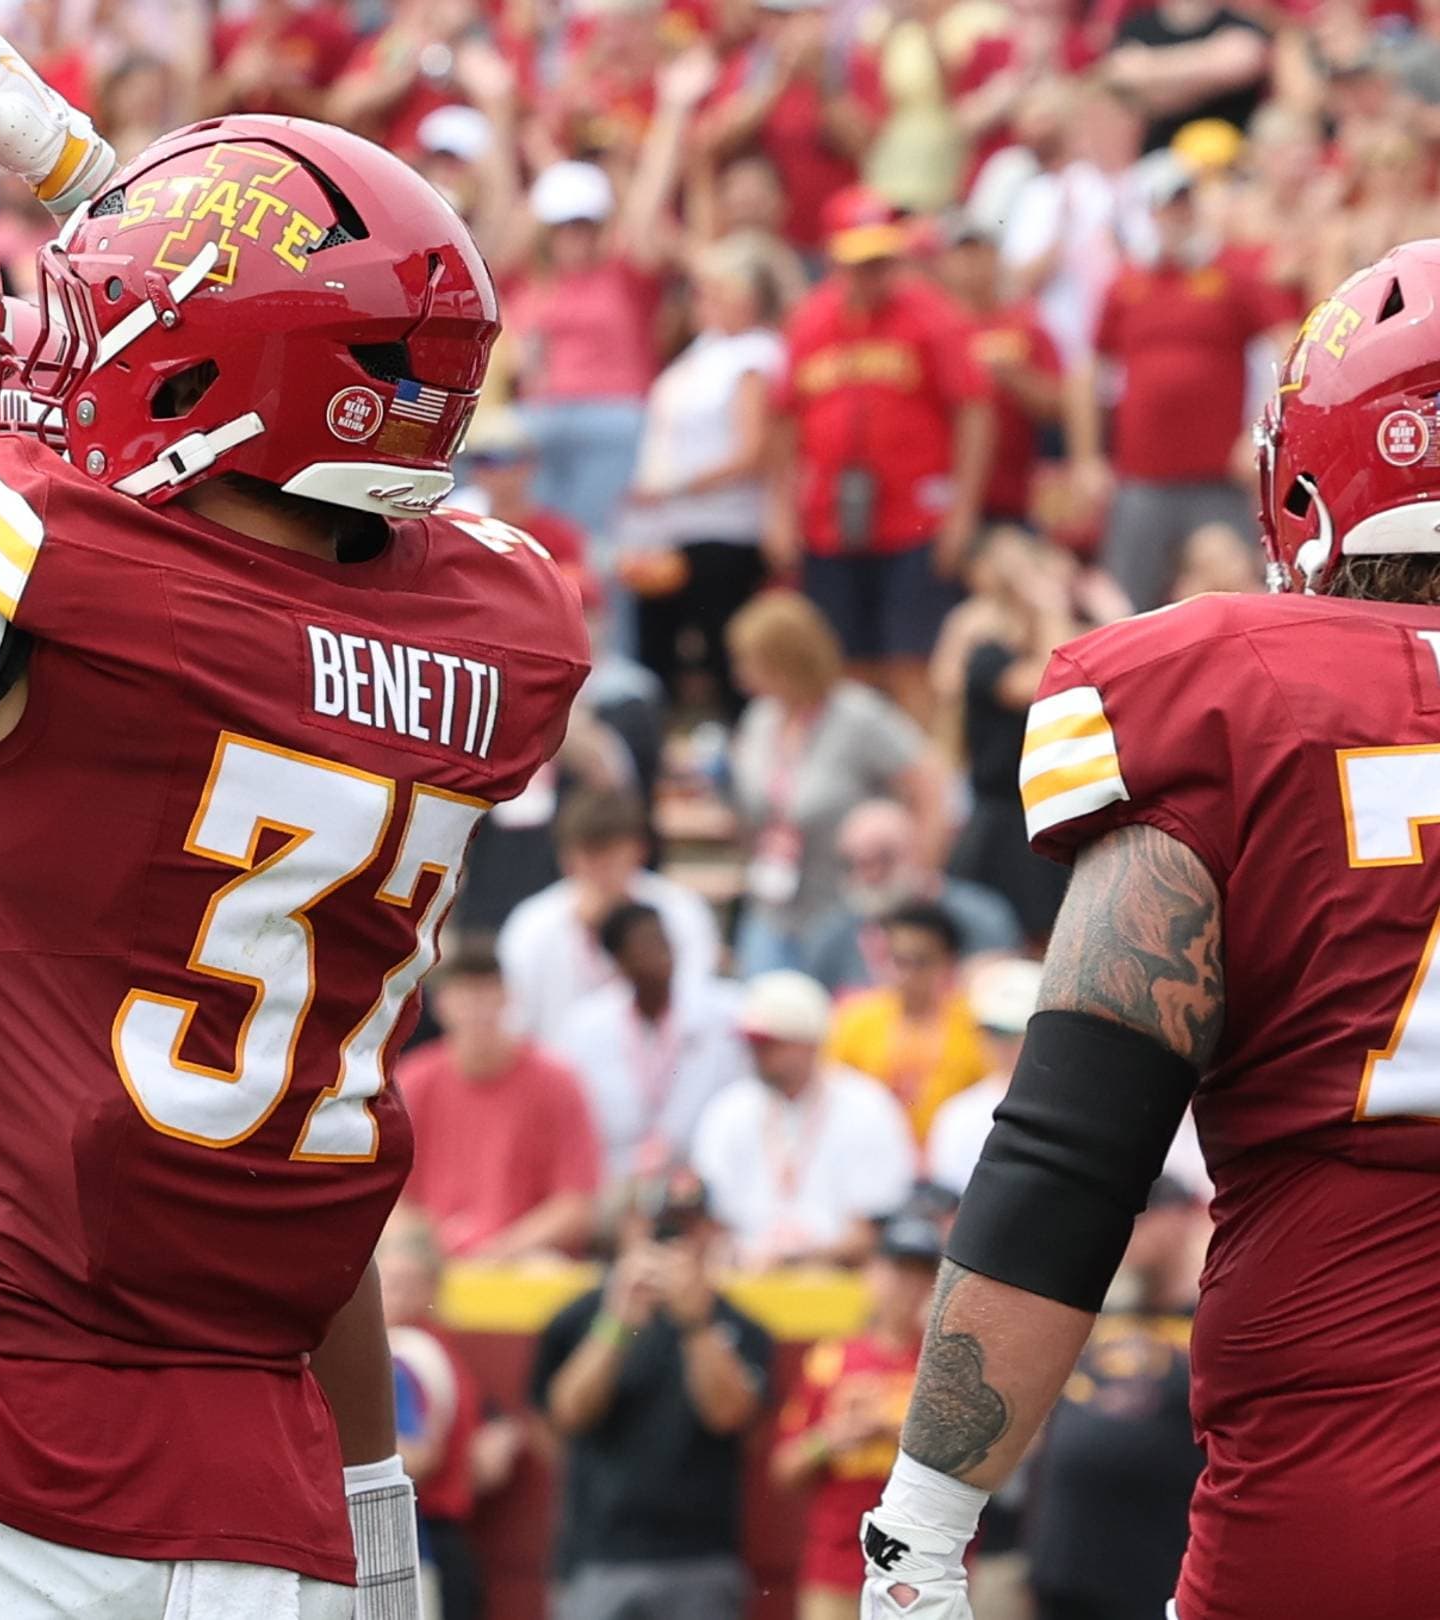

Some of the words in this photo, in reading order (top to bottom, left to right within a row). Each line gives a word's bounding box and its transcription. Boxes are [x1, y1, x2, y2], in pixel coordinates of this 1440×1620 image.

[117, 176, 324, 273] STATE
[344, 400, 372, 416] HEART
[307, 625, 500, 760] BENETTI
[111, 729, 496, 1163] 37
